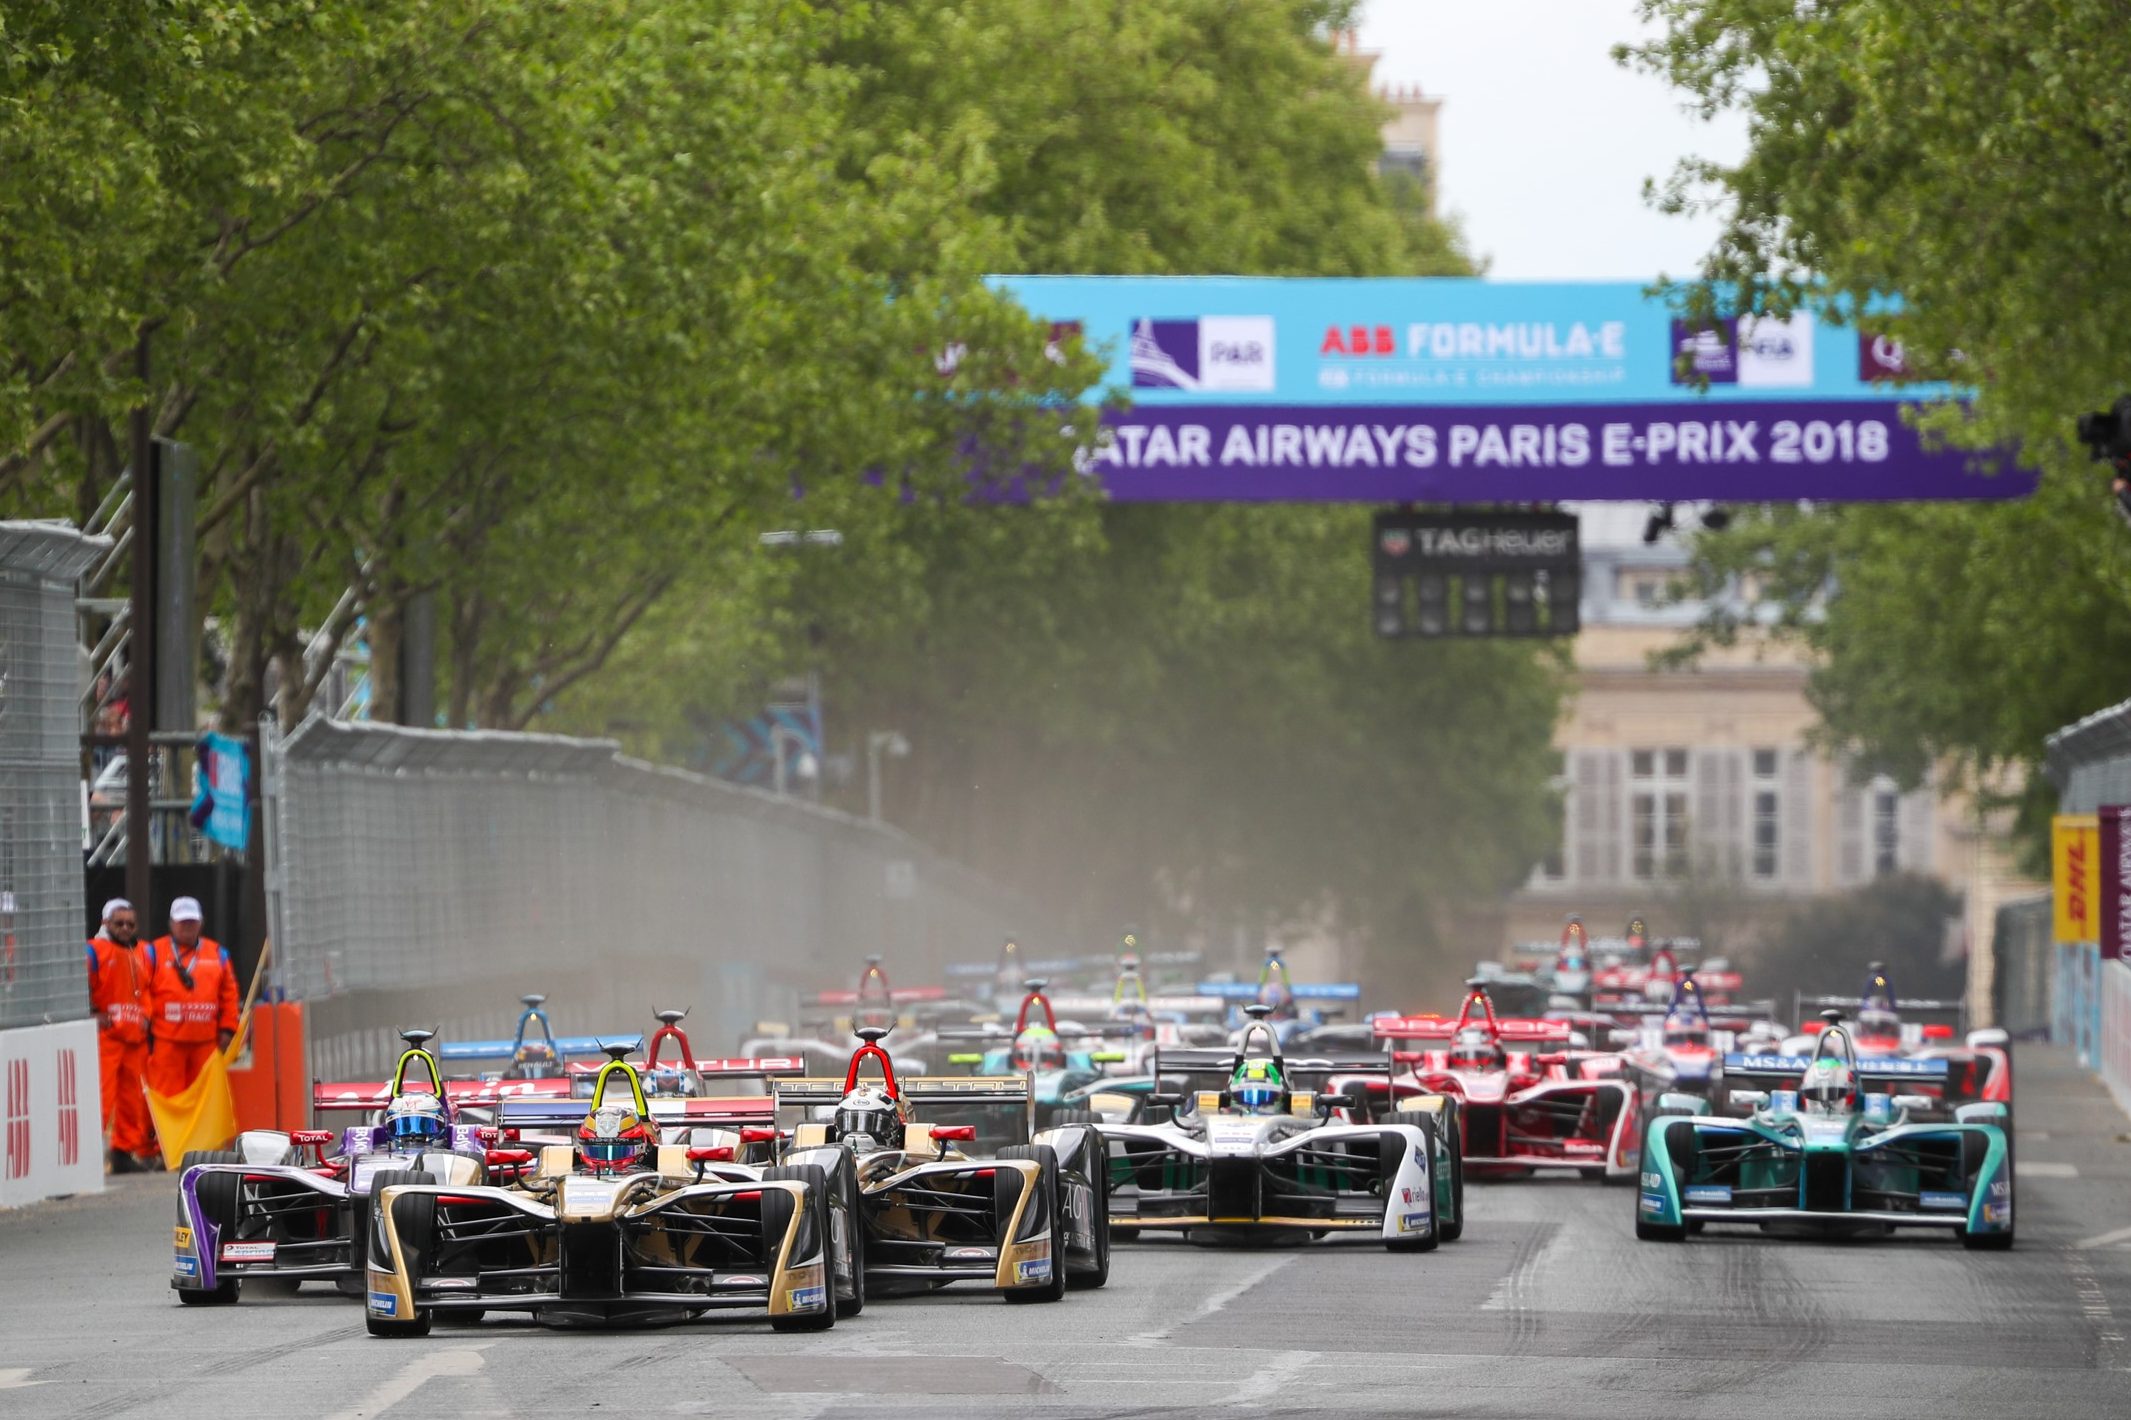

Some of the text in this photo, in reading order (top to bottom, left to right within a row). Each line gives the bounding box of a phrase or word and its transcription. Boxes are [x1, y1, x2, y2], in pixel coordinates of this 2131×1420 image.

[1321, 325, 1396, 356] ABB
[1219, 424, 1439, 468] AIRWAYS
[1448, 422, 1592, 468] PARIS
[1602, 420, 1760, 466] E-PRIX
[1769, 418, 1890, 464] 2018
[2067, 841, 2087, 922] DHL
[298, 1134, 328, 1142] TOTAL
[480, 1131, 510, 1139] TOTL
